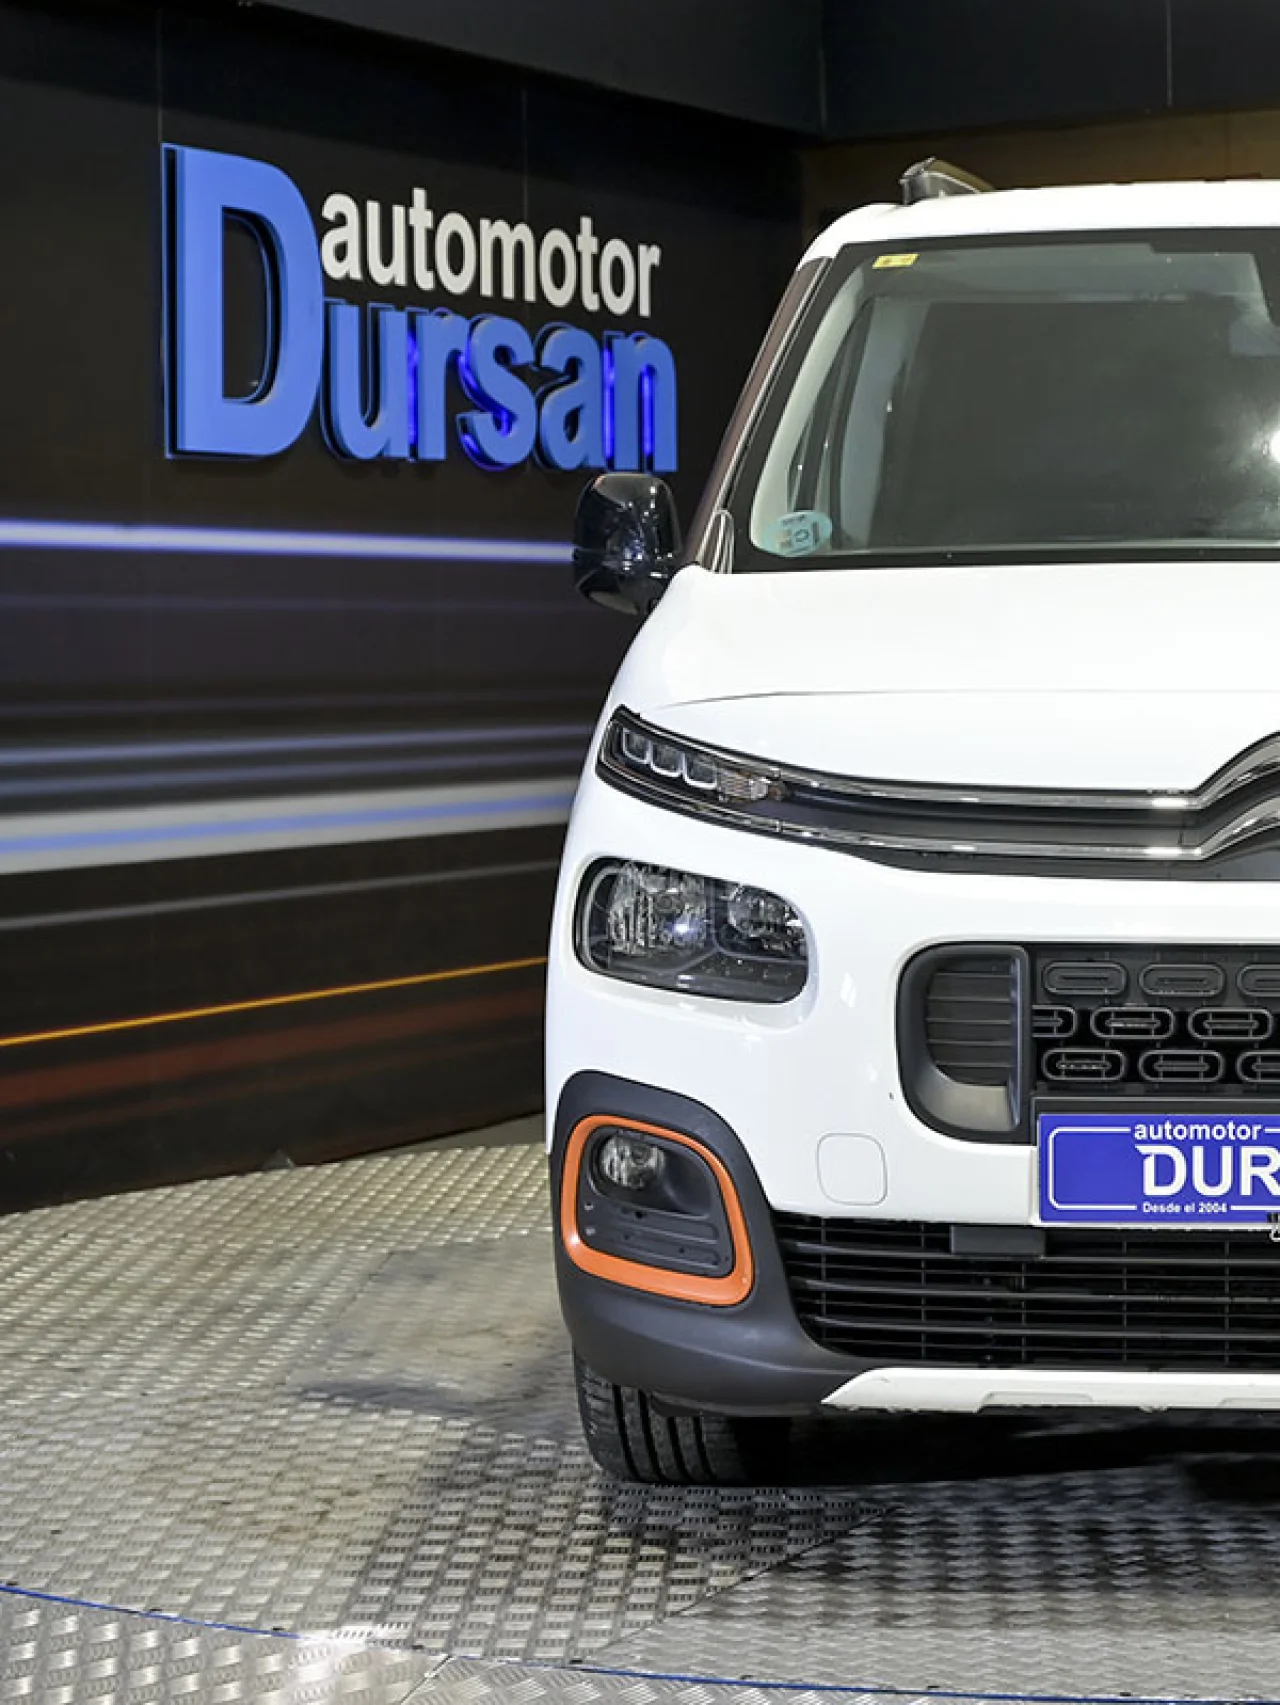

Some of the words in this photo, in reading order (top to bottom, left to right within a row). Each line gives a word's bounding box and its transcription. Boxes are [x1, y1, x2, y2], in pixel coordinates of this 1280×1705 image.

[321, 188, 660, 317] automotor
[162, 143, 677, 472] Dursan
[1134, 1120, 1262, 1140] automotor
[1143, 1202, 1181, 1213] Desde
[1184, 1202, 1195, 1213] el
[1198, 1202, 1227, 1213] 2004
